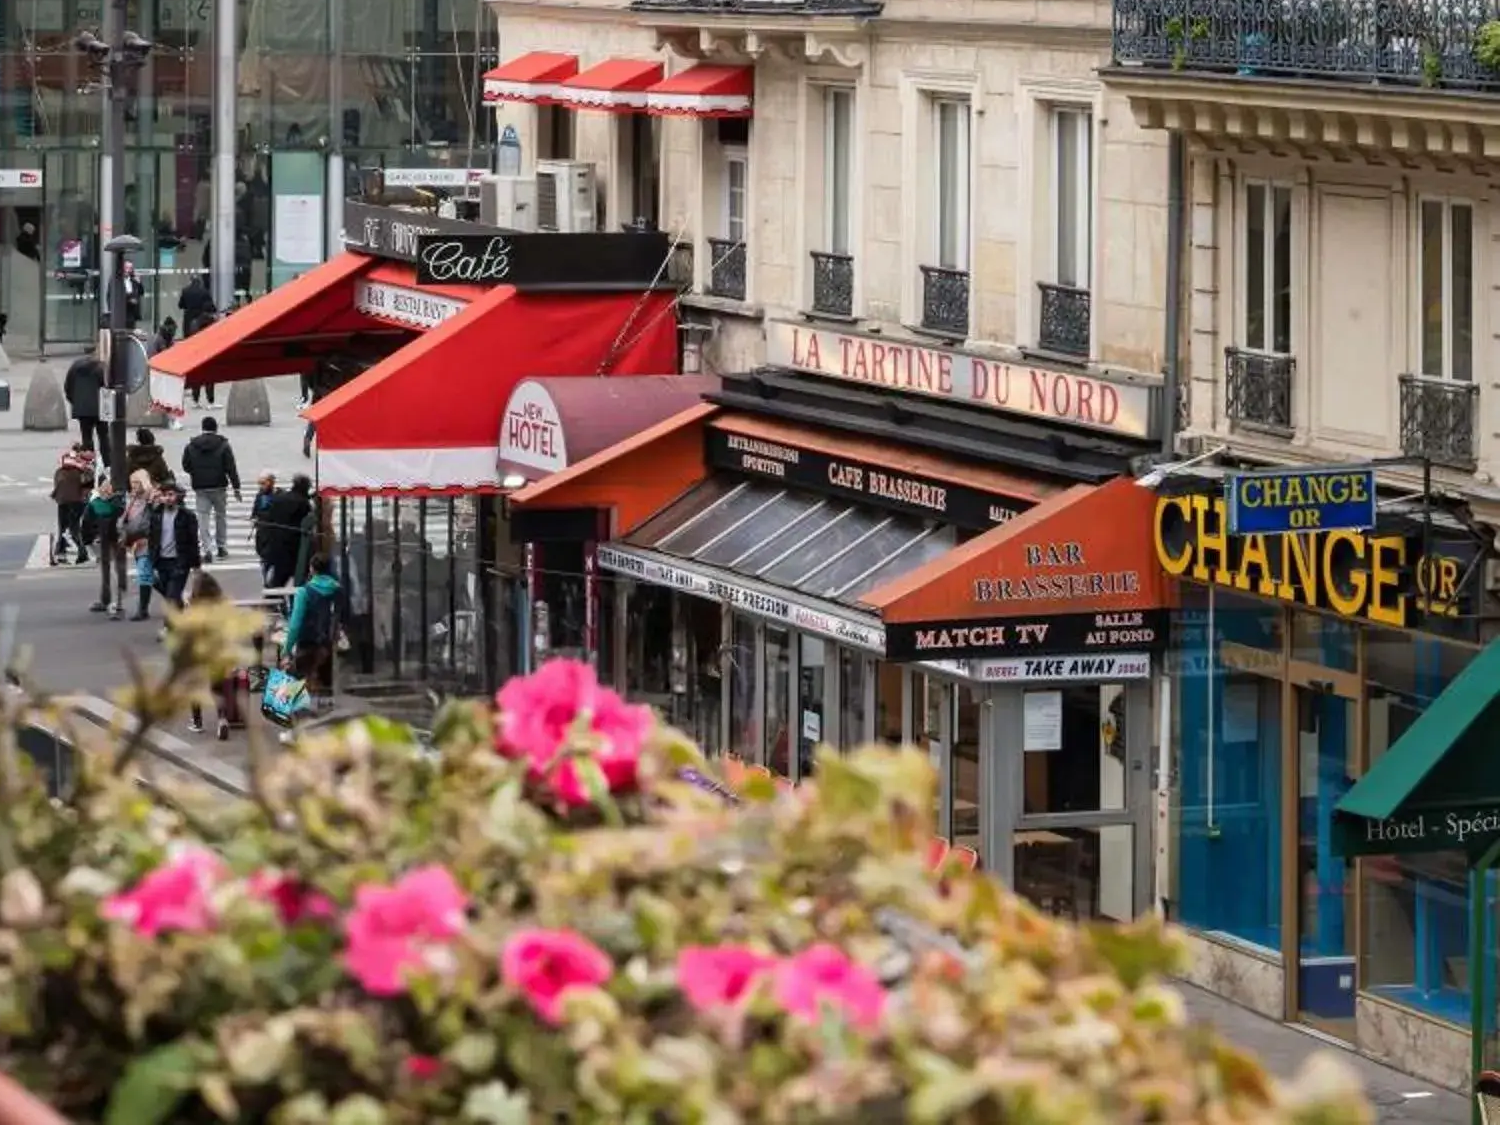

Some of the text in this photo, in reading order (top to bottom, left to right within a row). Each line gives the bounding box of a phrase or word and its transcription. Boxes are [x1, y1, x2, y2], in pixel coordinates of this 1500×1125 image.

[422, 237, 511, 282] Café
[791, 328, 1119, 425] LA TARTINE DU NORD
[523, 401, 543, 420] NEW
[509, 417, 558, 459] HOTEL
[828, 463, 947, 511] CAFE BRASSERIE
[1240, 474, 1369, 508] CHANGE
[1289, 509, 1321, 528] OR
[1025, 543, 1085, 566] BAR
[1154, 495, 1407, 627] CHANGE
[975, 572, 1140, 601] BRASSERIE
[742, 589, 790, 618] PRESSION
[1095, 613, 1144, 627] SALLE
[915, 624, 1049, 650] MATCH TV
[1085, 629, 1155, 645] AU FOND
[1024, 660, 1064, 677] TAKE
[1067, 659, 1117, 675] AWAY
[1366, 815, 1426, 841] Hôtel
[1444, 808, 1500, 842] Spéci
